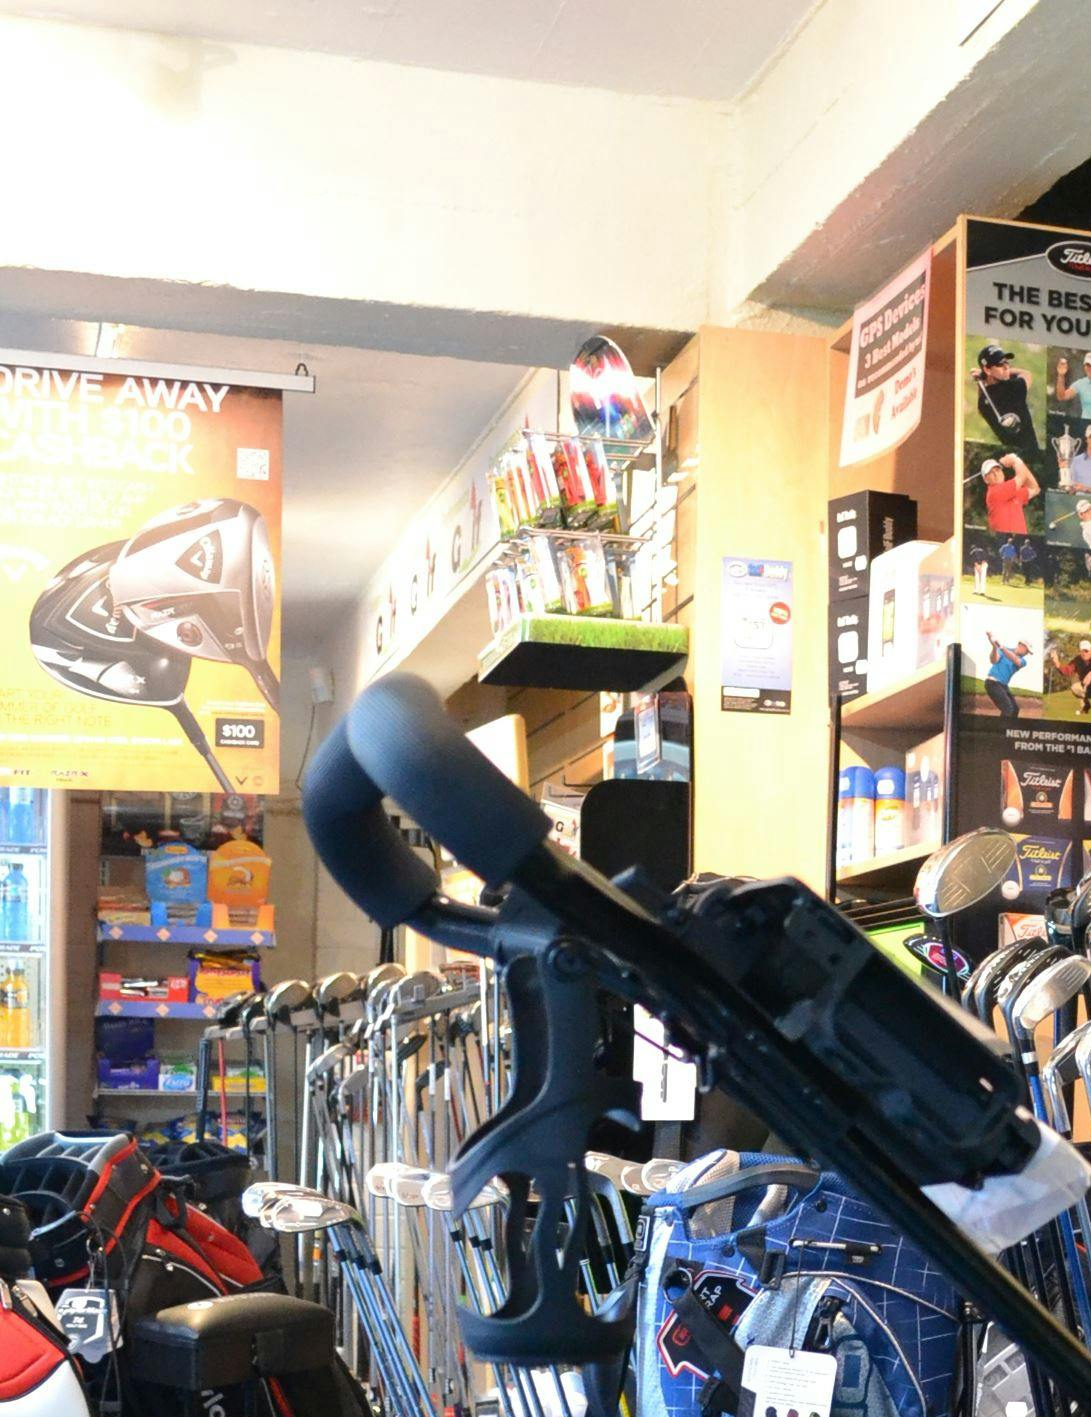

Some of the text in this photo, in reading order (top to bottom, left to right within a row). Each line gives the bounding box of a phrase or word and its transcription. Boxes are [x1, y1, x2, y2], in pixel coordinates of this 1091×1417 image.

[993, 281, 1040, 306] THE
[860, 284, 926, 348] GPS Devices
[984, 306, 1034, 330] FOR
[864, 353, 872, 369] 3
[872, 340, 891, 365] Best
[115, 377, 230, 413] AWAY
[103, 407, 192, 442] $100
[222, 724, 256, 738] $100
[1006, 729, 1031, 739] NEW
[1015, 741, 1044, 752] FROM
[1045, 744, 1065, 753] THE
[1020, 771, 1063, 788] Titleist
[1018, 844, 1062, 860] Titleist
